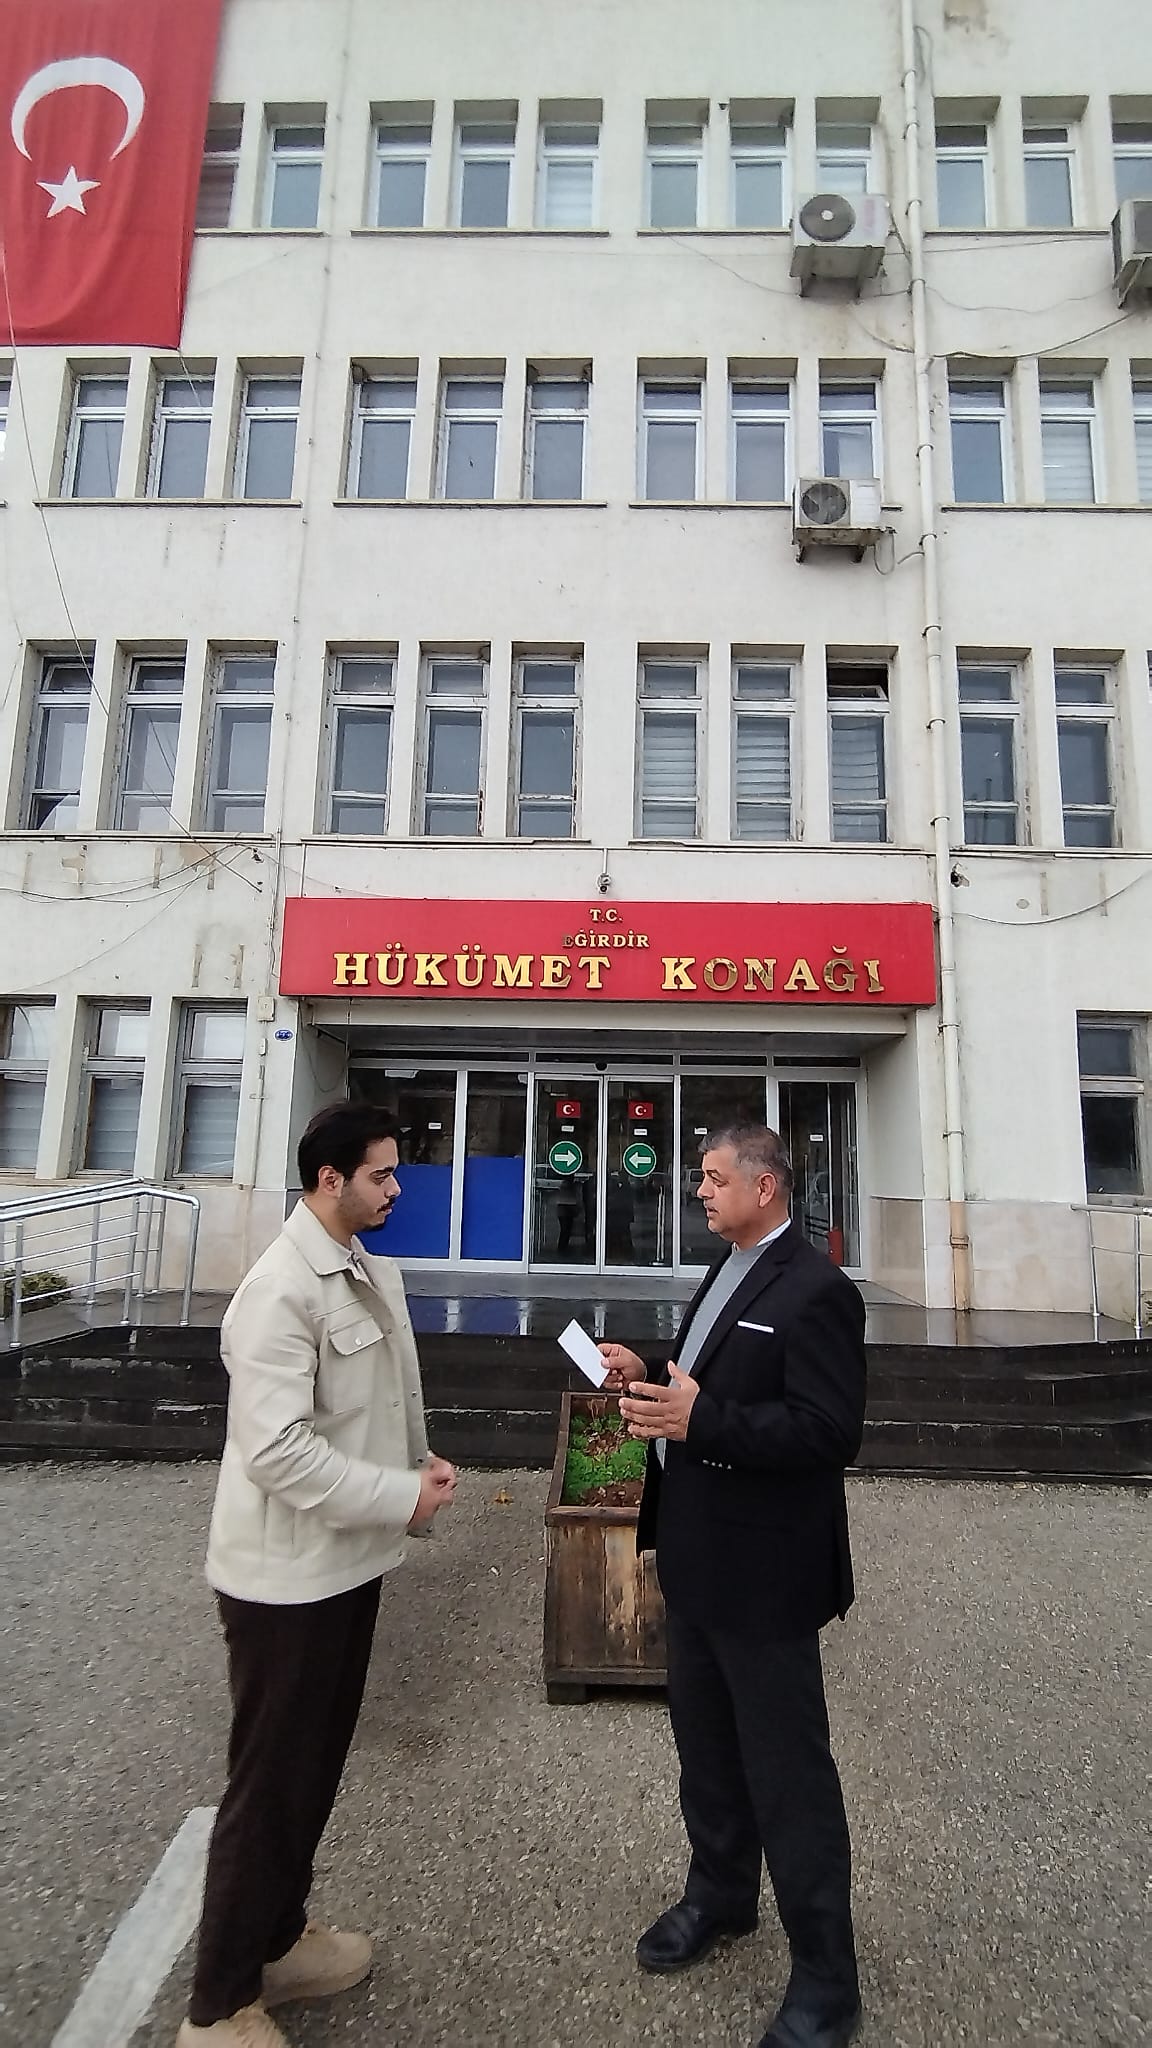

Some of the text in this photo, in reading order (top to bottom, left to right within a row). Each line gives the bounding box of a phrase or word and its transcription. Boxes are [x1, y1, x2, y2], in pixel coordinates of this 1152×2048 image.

[589, 908, 623, 922] T.C.
[562, 929, 649, 948] EĞİRDİR
[332, 942, 884, 993] HÜKÜMET KONAĞI
